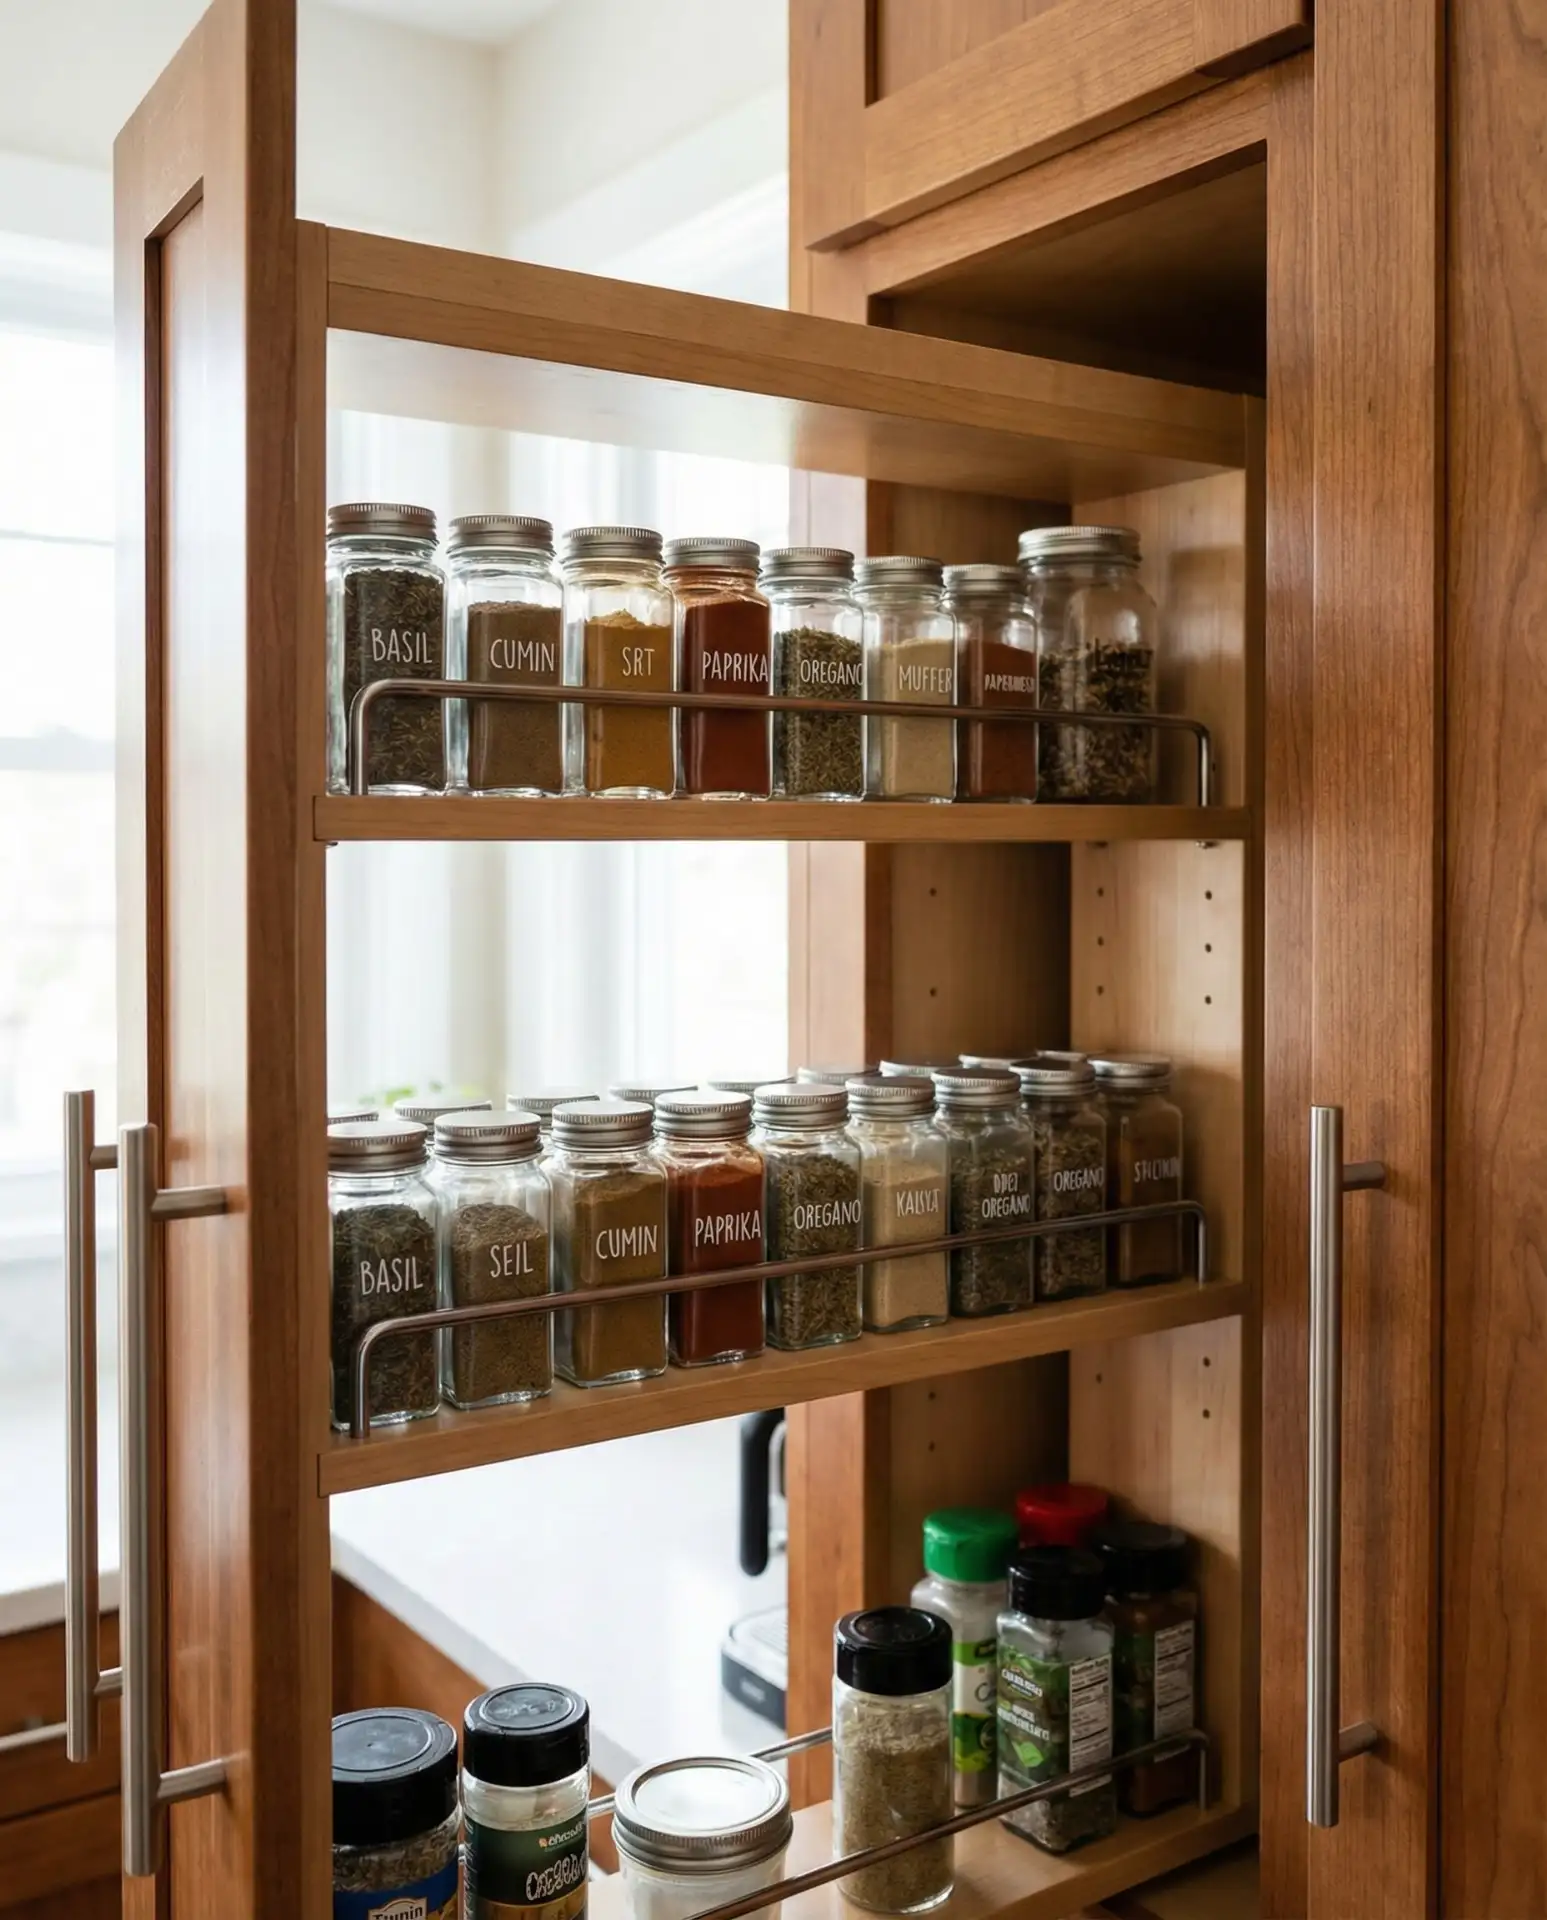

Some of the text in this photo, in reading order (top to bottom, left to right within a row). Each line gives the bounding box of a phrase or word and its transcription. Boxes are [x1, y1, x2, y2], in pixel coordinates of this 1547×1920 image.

[371, 628, 433, 665] BASIL
[490, 639, 555, 672] CUMIN
[622, 646, 656, 677] SRT
[702, 650, 769, 683] PAPRIKA
[1053, 1167, 1105, 1192] OREGANO
[793, 1199, 862, 1230] OREGANO
[982, 1194, 1031, 1219] OREGANO
[595, 1225, 658, 1260] CUMIN
[695, 1210, 762, 1248] PAPRIKA
[360, 1256, 424, 1296] BASIL
[489, 1241, 534, 1279] SEIL
